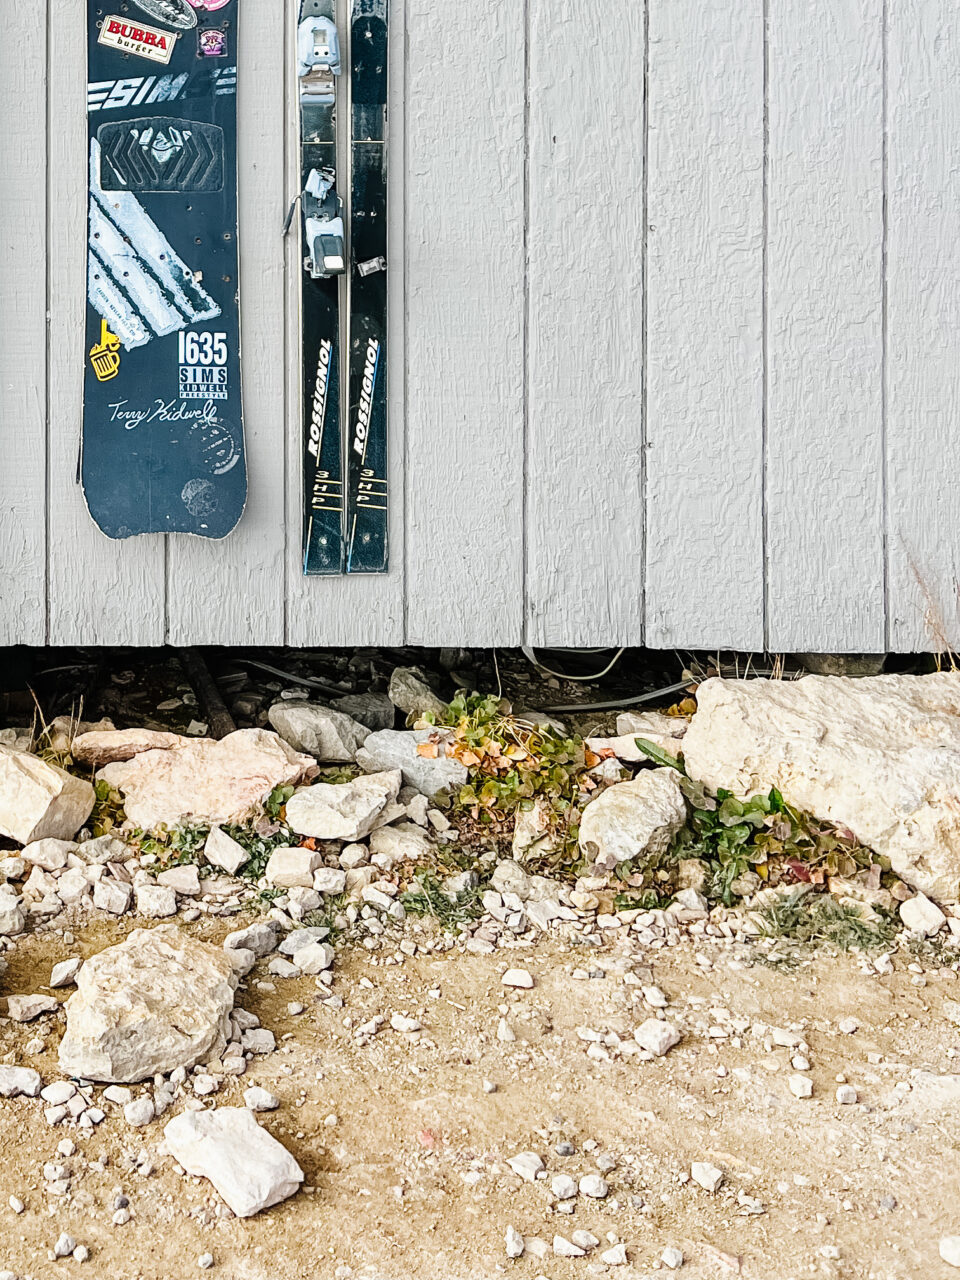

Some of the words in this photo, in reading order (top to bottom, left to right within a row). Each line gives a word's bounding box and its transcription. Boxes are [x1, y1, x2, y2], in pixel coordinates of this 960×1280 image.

[107, 20, 168, 51] BUBBA
[116, 36, 154, 55] burger
[178, 331, 228, 365] 1635
[179, 384, 227, 392] KIDWELL
[180, 368, 226, 383] SIMS
[308, 338, 332, 457] ROSSIGNOL
[353, 337, 380, 456] ROSSIGNOL
[108, 399, 150, 429] Terry
[147, 398, 218, 424] Kidwell
